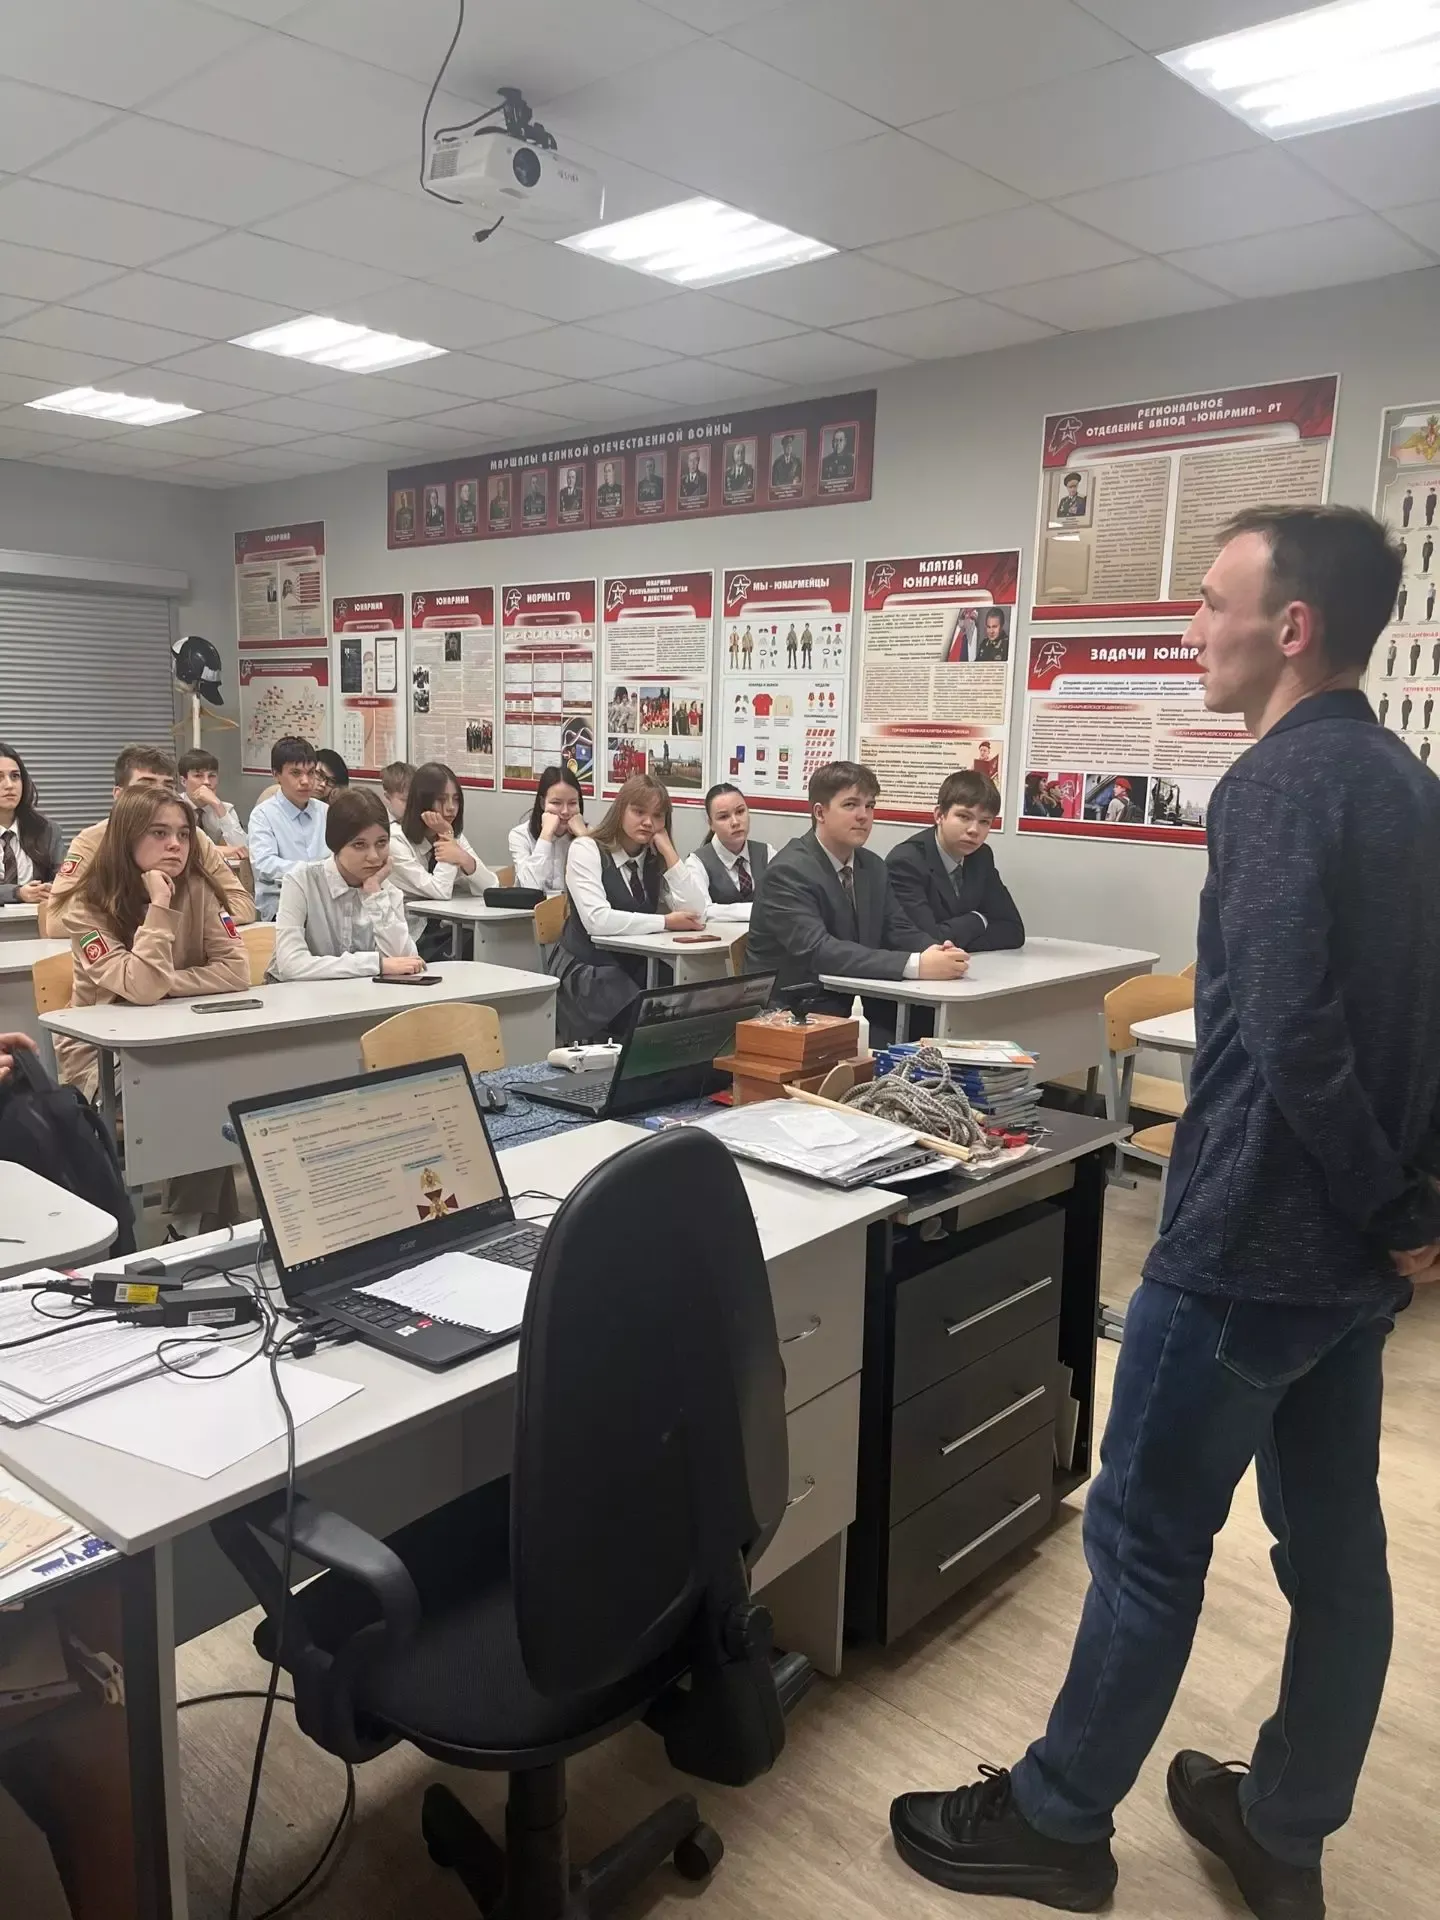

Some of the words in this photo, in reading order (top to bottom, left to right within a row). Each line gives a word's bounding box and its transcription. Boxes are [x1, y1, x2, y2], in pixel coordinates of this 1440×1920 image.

[1138, 398, 1223, 419] РЕГИОНАЛЬНОЕ
[1086, 420, 1144, 437] ОТДЕЛЕНИЕ
[1149, 415, 1186, 429] ВВПОД
[1268, 402, 1282, 413] РТ
[490, 456, 539, 471] МАРШАЛЫ
[541, 445, 589, 463] ВЕЛИКОЙ
[592, 428, 684, 455] ОТЕЧЕСТВЕННОЙ
[688, 422, 733, 439] ВОЙНЫ
[919, 559, 963, 573] КЛЯТВА
[753, 581, 769, 591] МЫ
[774, 578, 830, 590] ЮНАРМЕЙЦЫ
[903, 571, 979, 589] ЮНАРМЕЙЦА
[436, 595, 470, 606] ЮНАРМИЯ
[526, 592, 556, 604] НОРМЫ
[557, 591, 571, 602] ГТО
[1090, 648, 1146, 662] ЗАДАЧИ
[1153, 647, 1199, 660] ЮНАР
